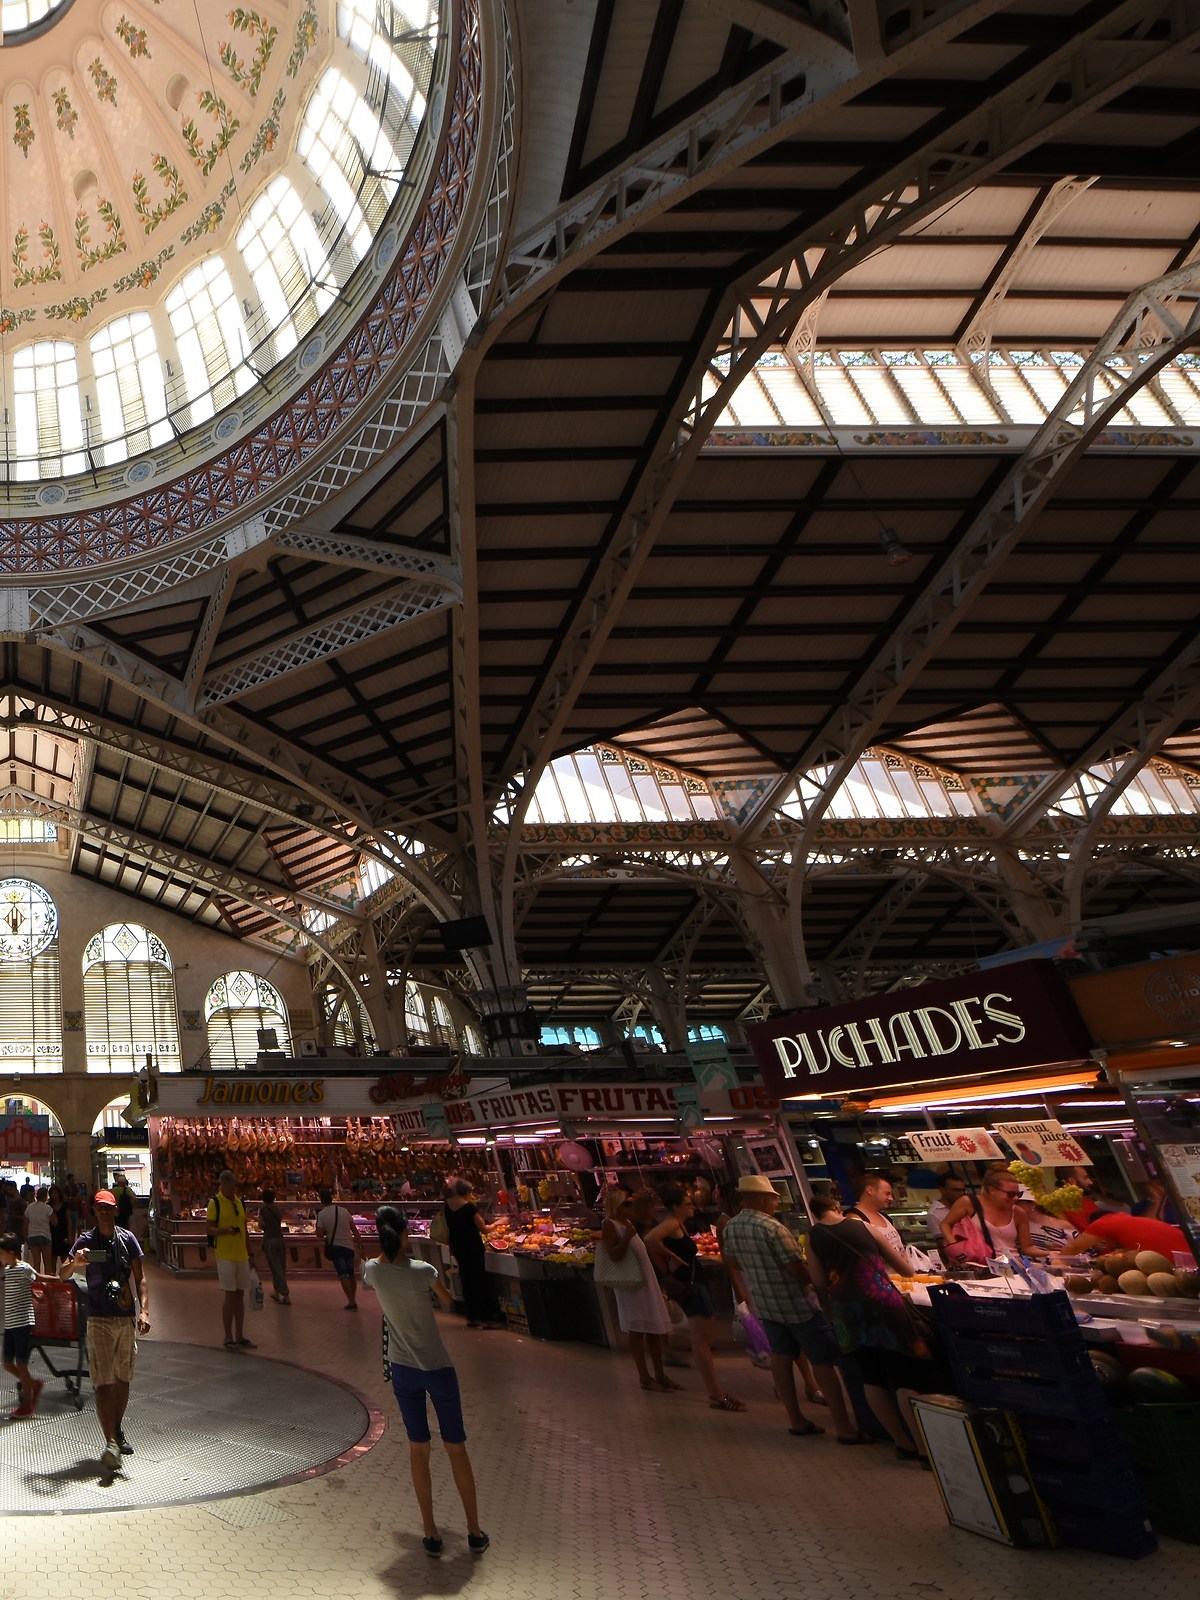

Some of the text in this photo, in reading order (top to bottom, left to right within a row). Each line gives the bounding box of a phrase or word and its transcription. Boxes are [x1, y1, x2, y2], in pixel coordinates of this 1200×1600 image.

[771, 992, 1026, 1079] PUCHADES
[197, 1076, 325, 1104] Jamones
[557, 1087, 678, 1112] FRUTAS
[478, 1088, 556, 1121] FRUTAS
[912, 1132, 956, 1148] Fruit
[998, 1122, 1049, 1135] Natural
[1038, 1131, 1072, 1145] juice
